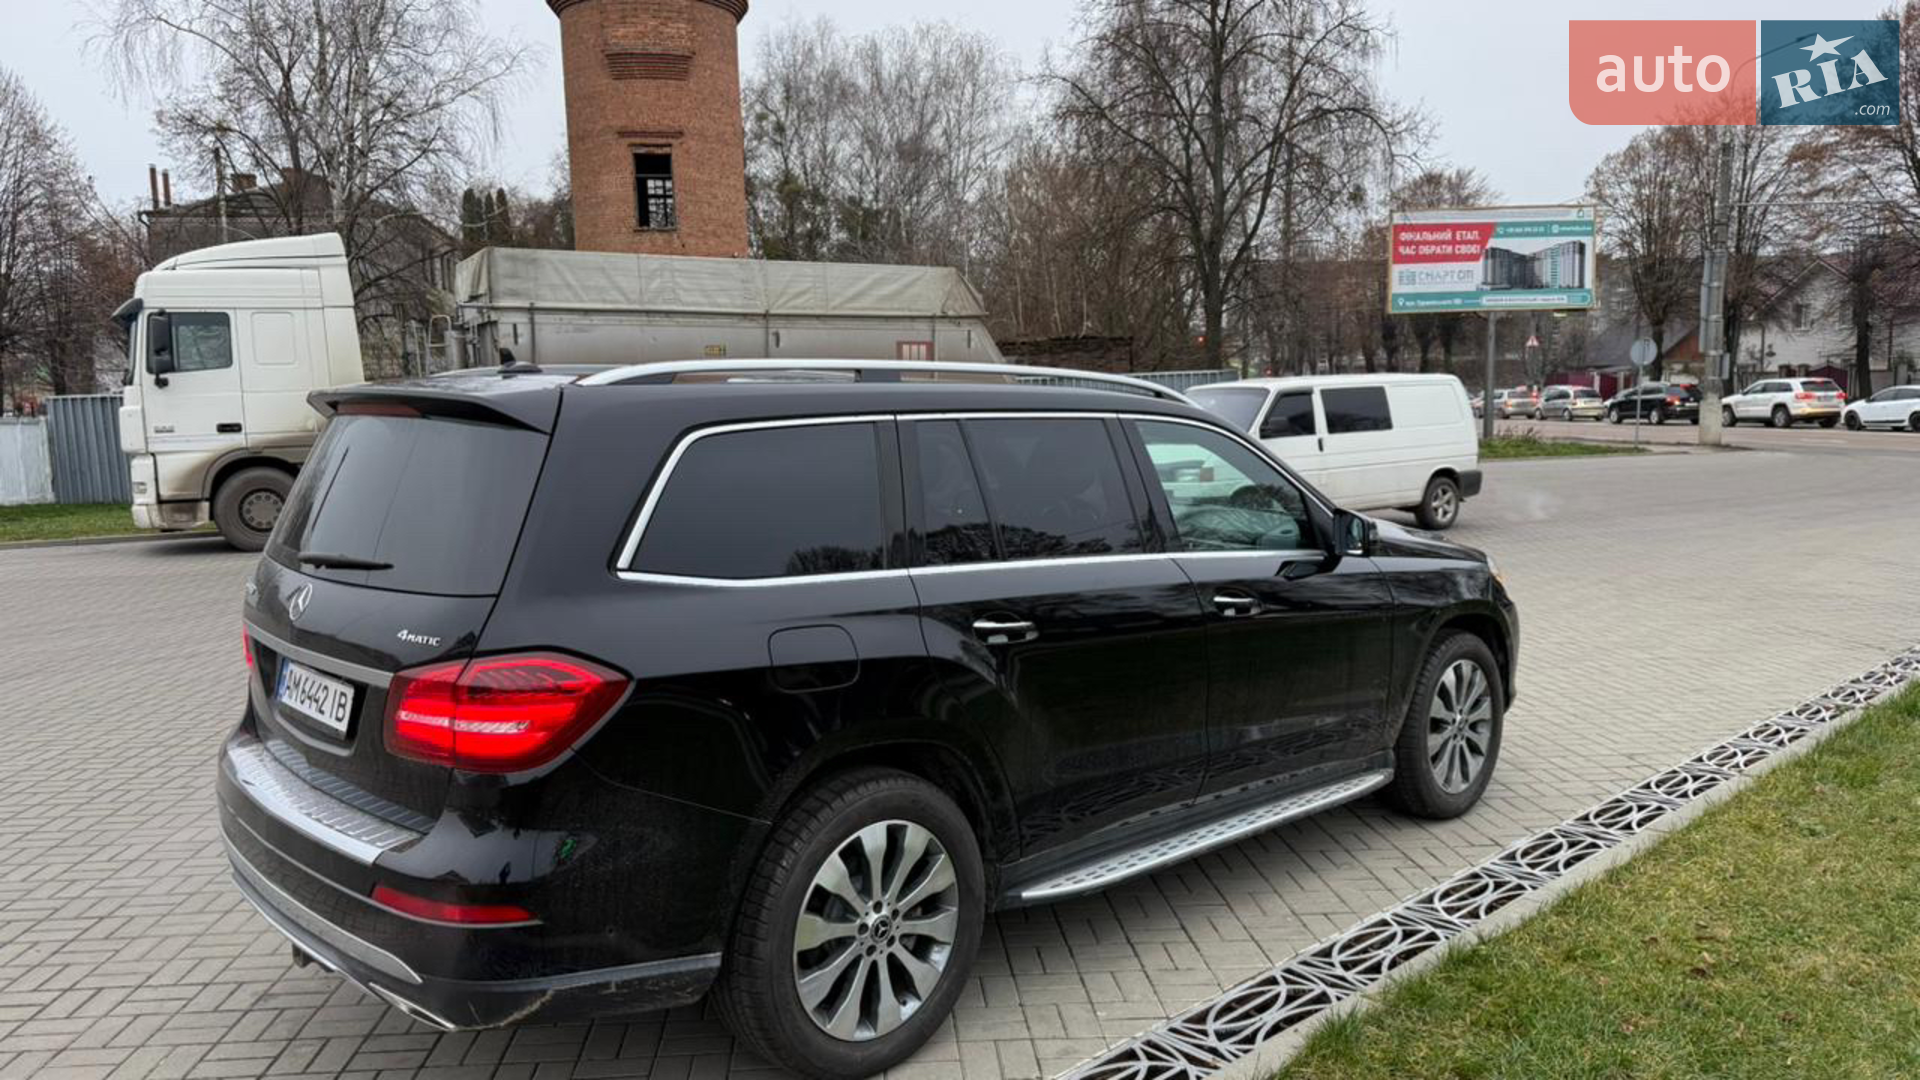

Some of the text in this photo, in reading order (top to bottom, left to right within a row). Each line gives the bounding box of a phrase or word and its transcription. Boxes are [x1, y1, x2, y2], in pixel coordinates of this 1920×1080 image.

[1399, 229, 1453, 241] ФІНАЛЬНИЙ
[1398, 245, 1417, 256] ЧАС
[1418, 245, 1453, 255] ОБРАТИ
[397, 629, 441, 647] 4MATIC
